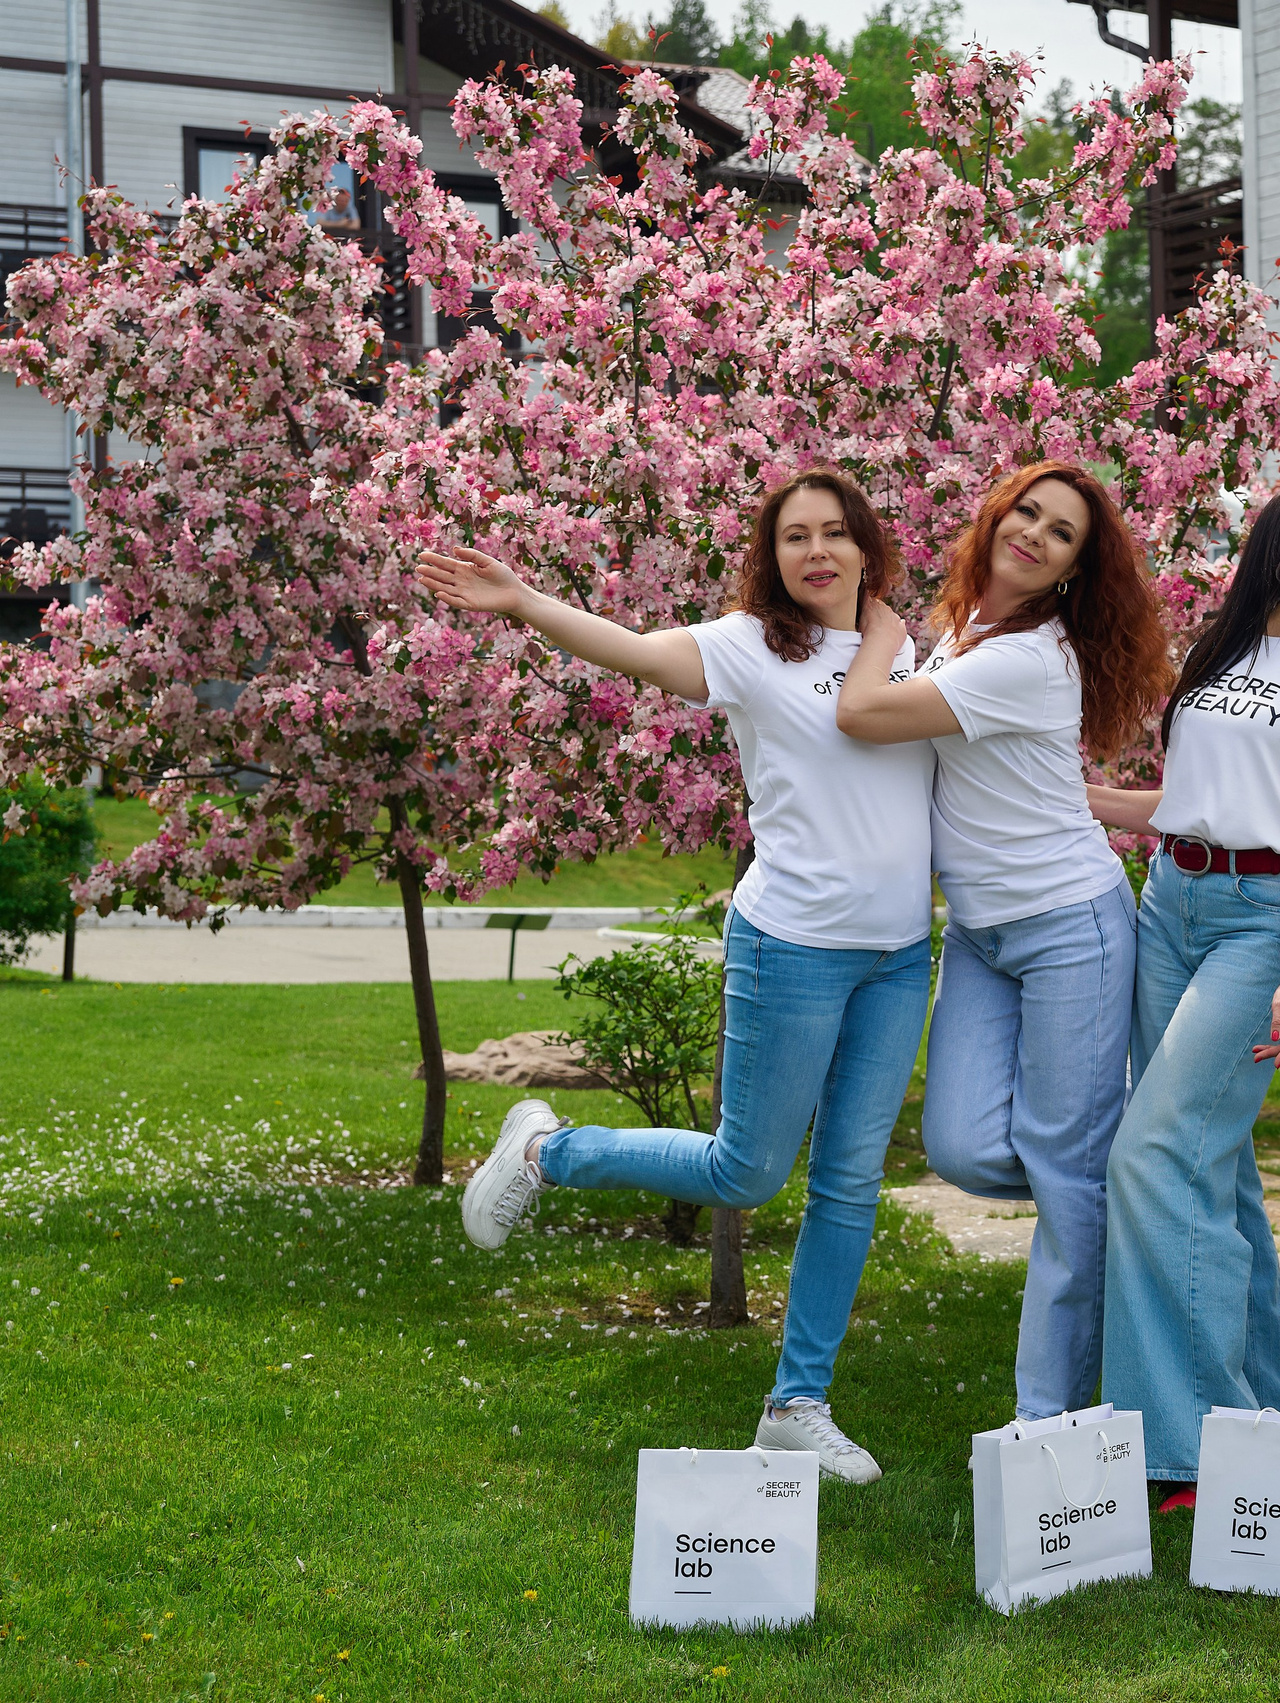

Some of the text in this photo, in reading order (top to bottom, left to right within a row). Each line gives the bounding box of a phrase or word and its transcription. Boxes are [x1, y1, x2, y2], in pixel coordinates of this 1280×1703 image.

[765, 1490, 801, 1498] BEAUTY
[766, 1481, 801, 1490] SECRET
[1038, 1500, 1117, 1532] Science
[1231, 1518, 1267, 1541] lab
[675, 1532, 776, 1553] Science
[1040, 1532, 1071, 1556] lab
[674, 1557, 713, 1578] lab
